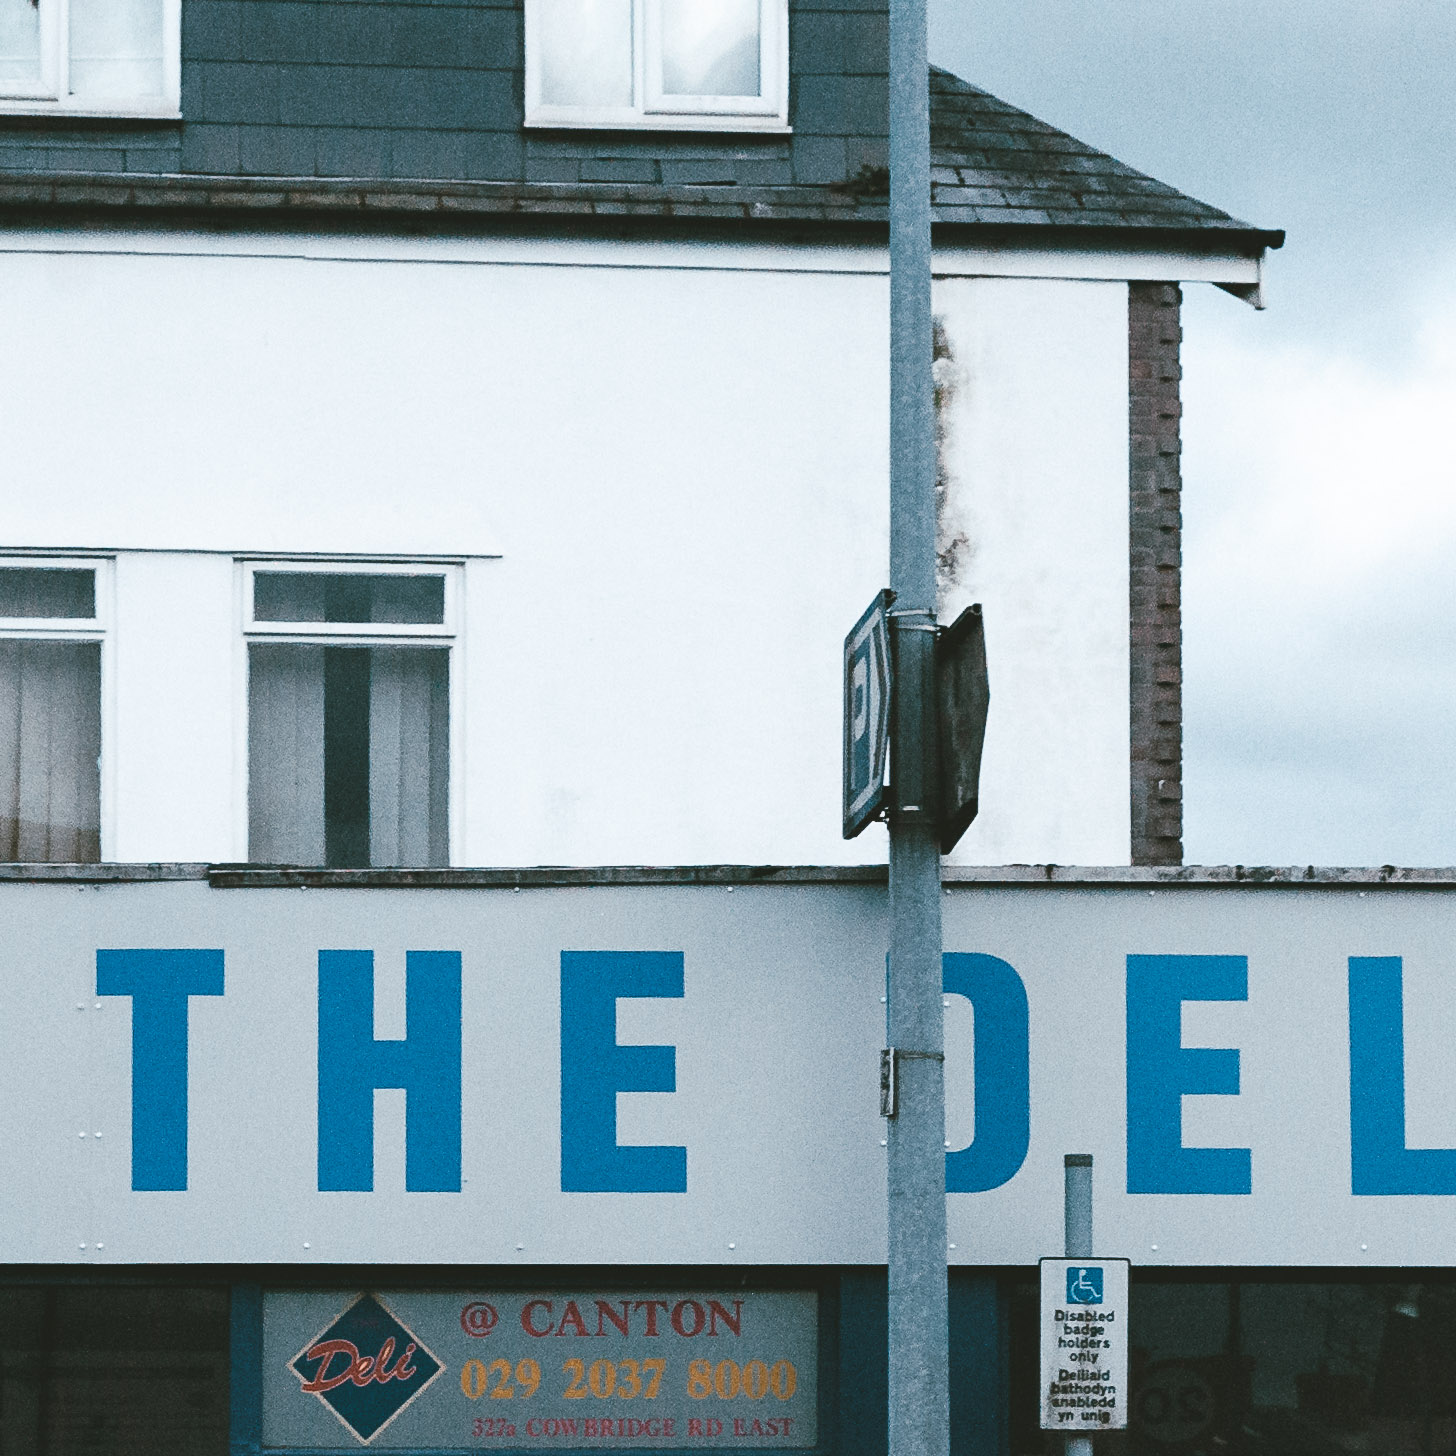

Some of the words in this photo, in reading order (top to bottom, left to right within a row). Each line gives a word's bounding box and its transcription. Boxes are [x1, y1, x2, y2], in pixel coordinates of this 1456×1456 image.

[95, 948, 687, 1194] THE
[459, 1300, 499, 1339] @
[520, 1299, 745, 1338] CANTON
[1054, 1309, 1115, 1322] Disabled
[1063, 1323, 1105, 1337] badge
[1058, 1337, 1111, 1348] holders
[300, 1335, 417, 1393] Deli
[1069, 1351, 1099, 1364] only
[460, 1358, 542, 1400] 029
[562, 1357, 667, 1400] 2037
[687, 1358, 797, 1401] 8000
[1050, 1381, 1116, 1397] bathodyn
[1051, 1396, 1116, 1408] anabledd
[1057, 1411, 1075, 1423] yn
[525, 1417, 677, 1438] COWBRIDGE
[687, 1417, 723, 1438] RD
[733, 1417, 795, 1438] EAST
